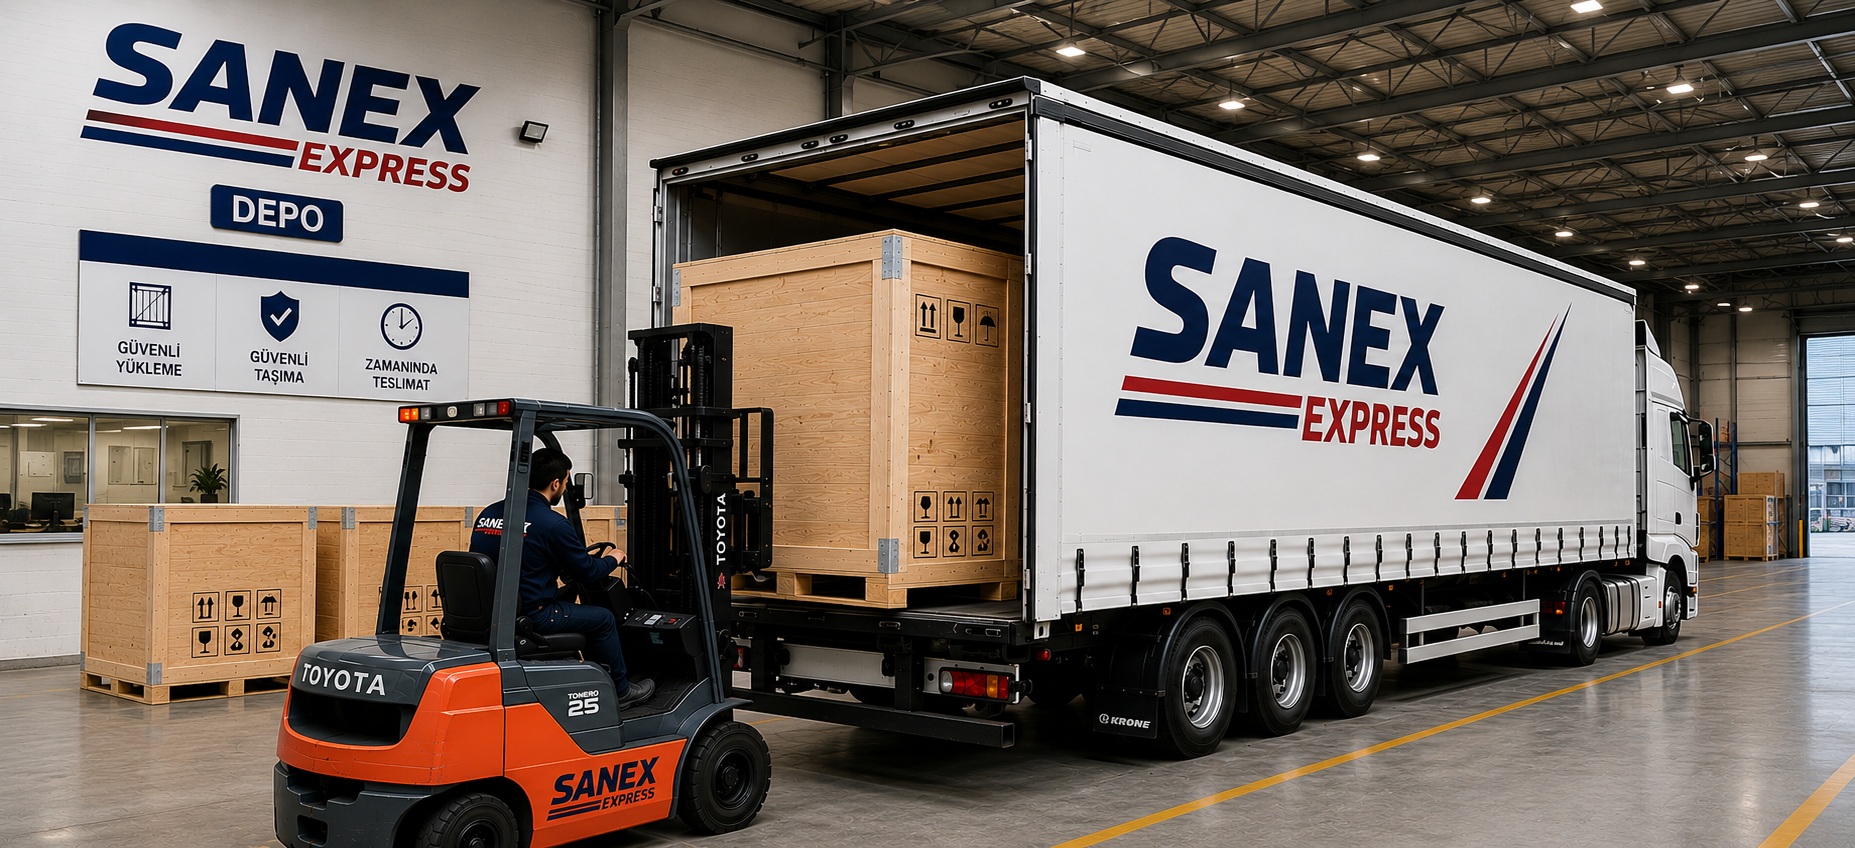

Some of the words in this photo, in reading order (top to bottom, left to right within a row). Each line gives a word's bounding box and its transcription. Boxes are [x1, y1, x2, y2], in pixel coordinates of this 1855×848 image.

[93, 23, 481, 154] SANEX
[299, 142, 471, 192] EXPRESS
[232, 195, 325, 232] DEPO
[1130, 236, 1445, 396] SANEX
[117, 339, 181, 358] GÜVENLİ
[250, 349, 309, 366] GÜVENLİ
[116, 358, 182, 377] YÜKLEME
[254, 368, 305, 386] TAŞIMA
[365, 358, 438, 375] ZAMANINDA
[373, 376, 430, 391] TESLIMAT
[1301, 396, 1441, 450] EXPRESS
[716, 493, 726, 566] TOYOTA
[302, 663, 386, 696] TOYOTA
[568, 697, 600, 717] 25
[1110, 716, 1151, 729] KRONE
[551, 756, 660, 806] SANEX
[601, 787, 656, 810] EXPRESS
